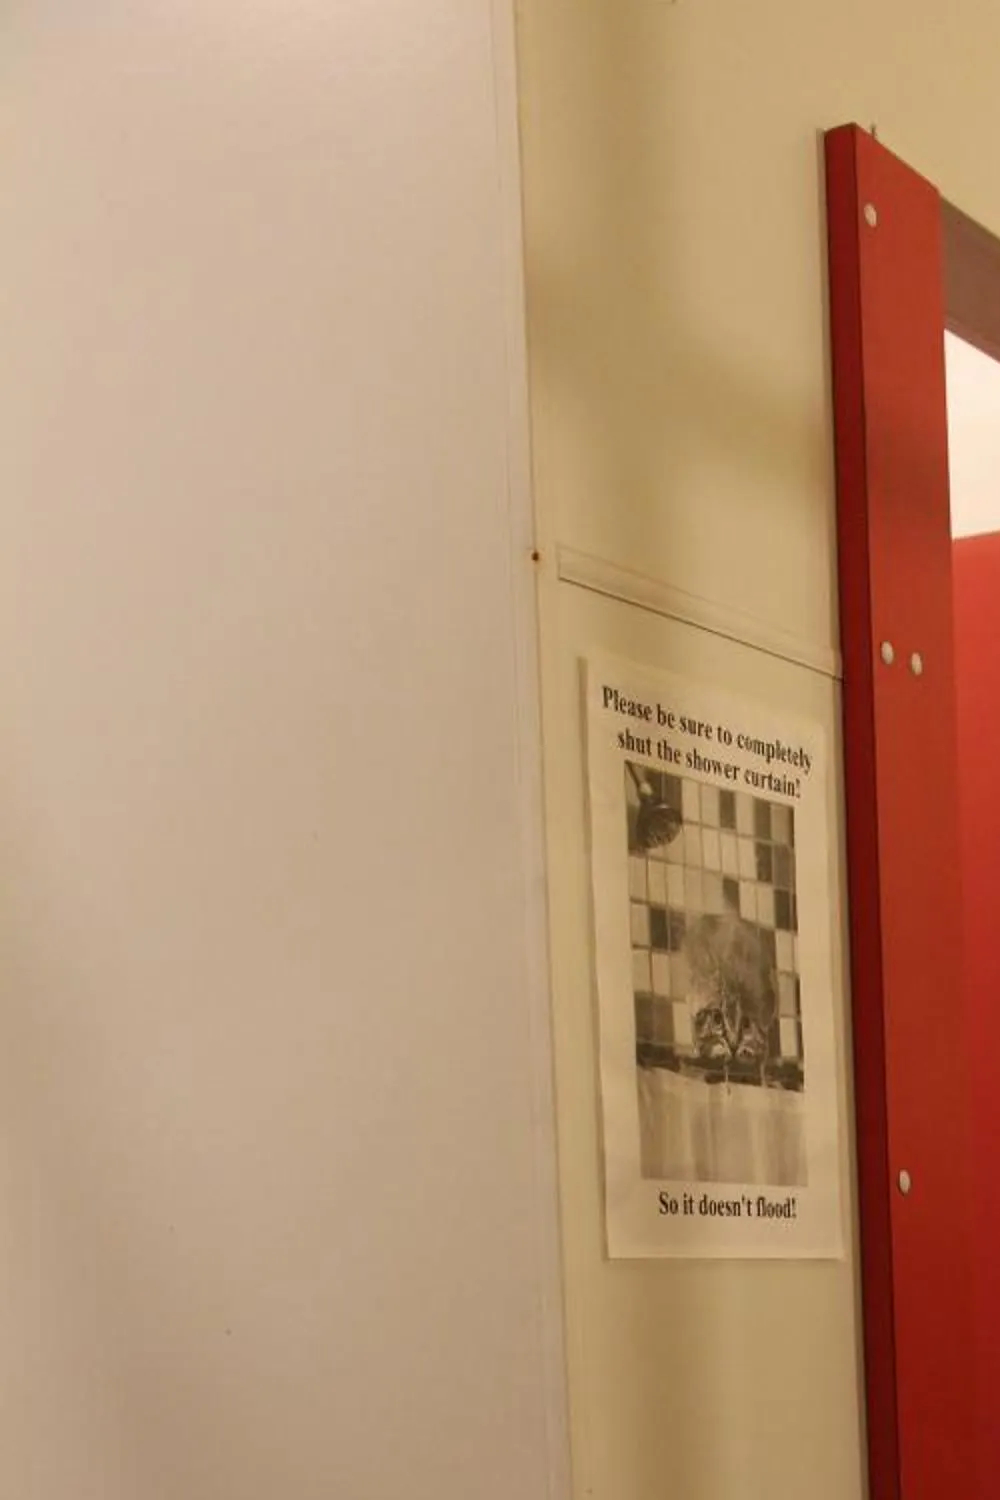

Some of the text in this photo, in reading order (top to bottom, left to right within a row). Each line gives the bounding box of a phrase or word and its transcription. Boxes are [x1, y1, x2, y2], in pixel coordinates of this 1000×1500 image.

[602, 685, 812, 775] Please be sure to completely
[617, 728, 801, 798] shut the shower curtain!
[658, 1191, 797, 1219] So it doesn't flood!
